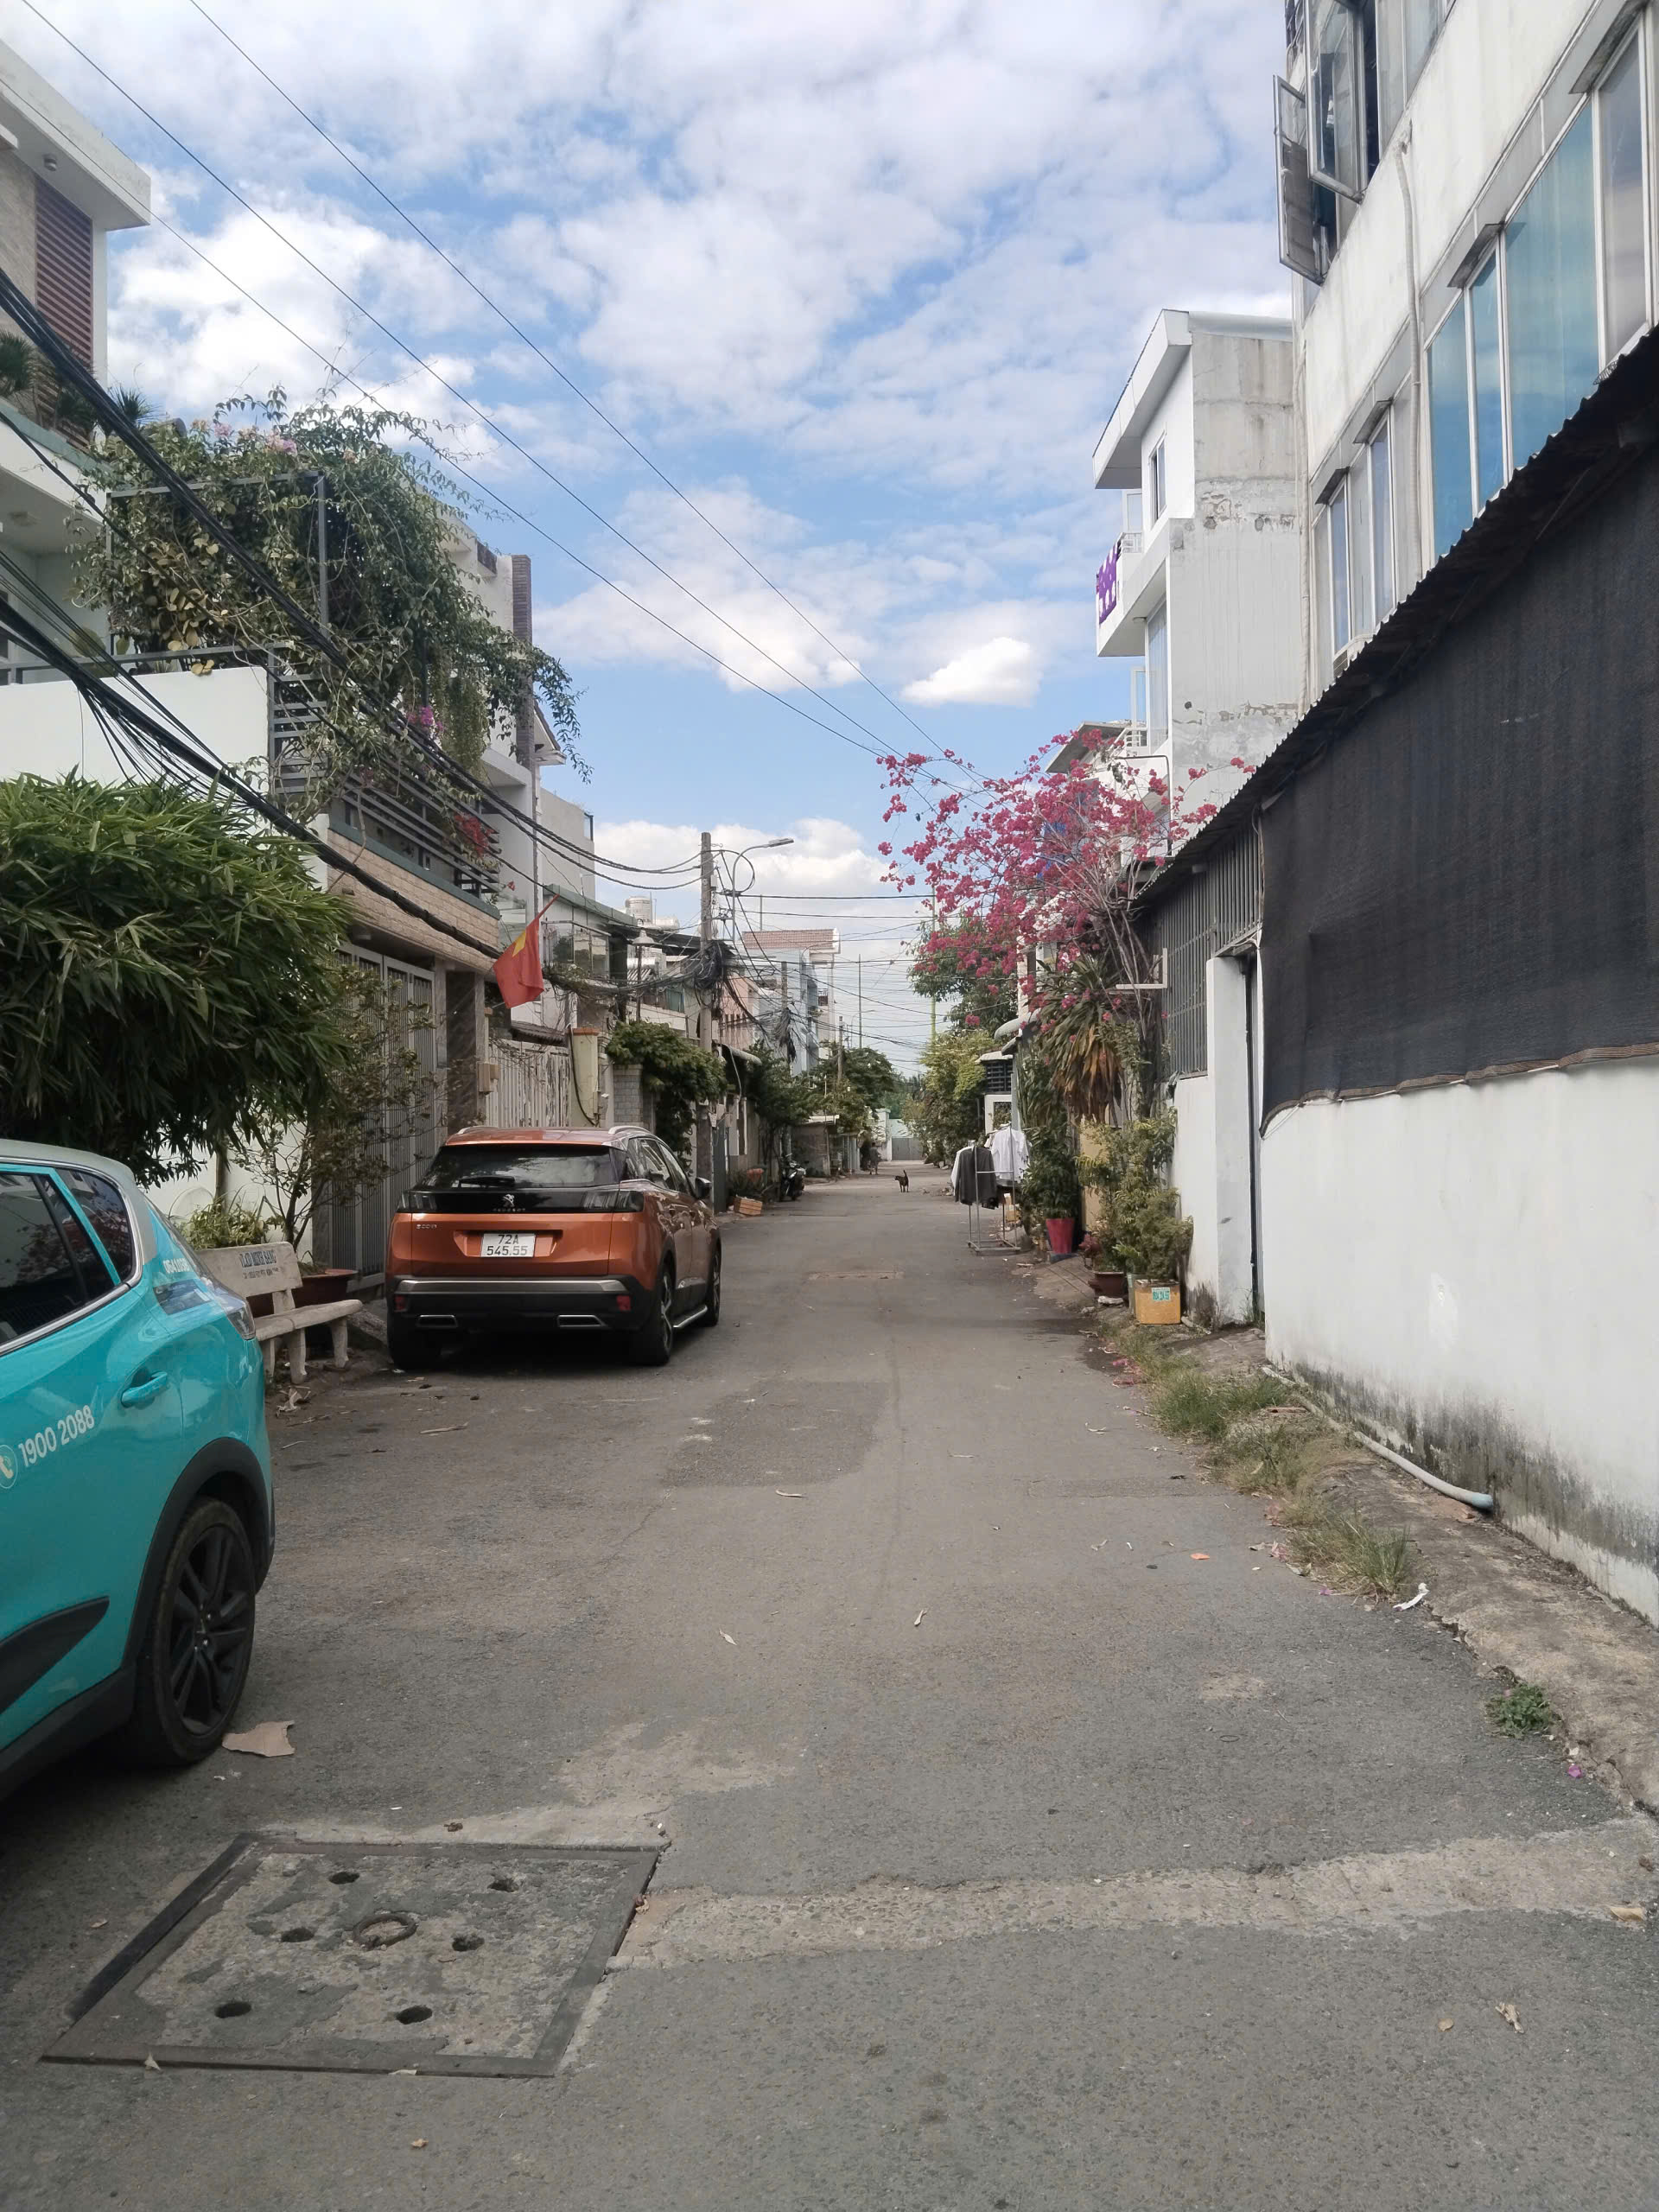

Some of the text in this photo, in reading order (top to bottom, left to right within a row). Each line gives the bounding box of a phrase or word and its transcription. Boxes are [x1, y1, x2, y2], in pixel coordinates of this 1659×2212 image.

[499, 1235, 519, 1244] 72A
[486, 1246, 528, 1255] 545.55
[18, 1405, 95, 1467] 1900 2088
